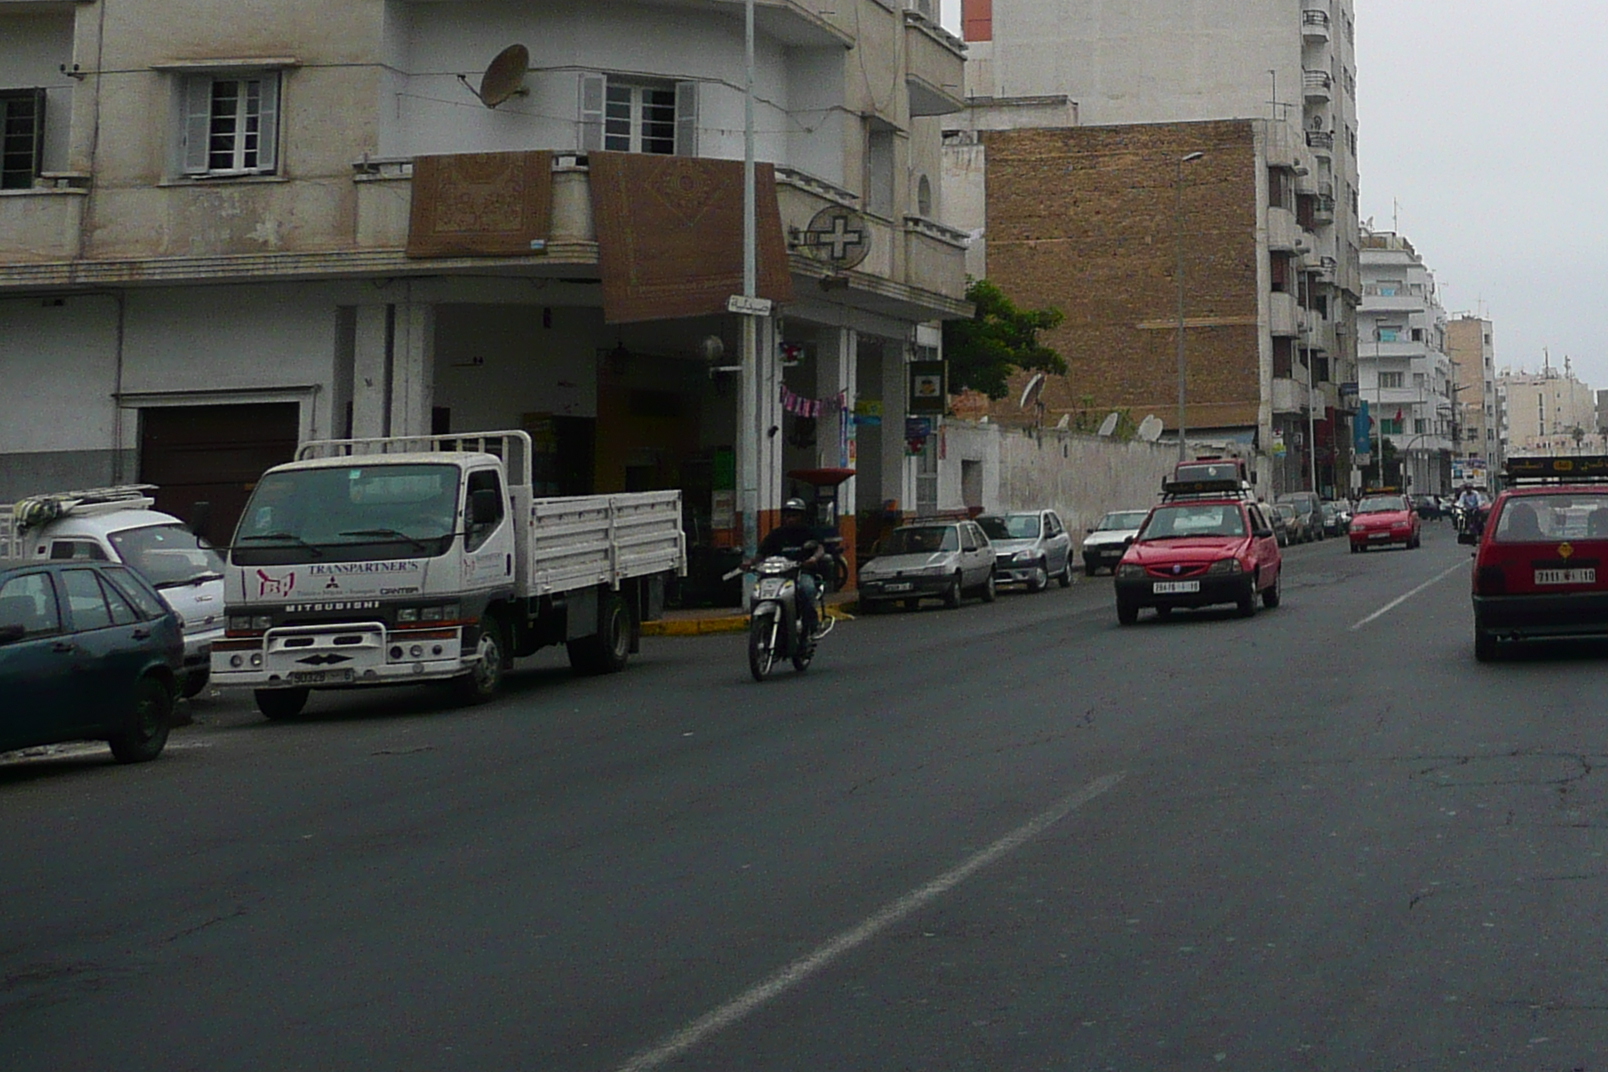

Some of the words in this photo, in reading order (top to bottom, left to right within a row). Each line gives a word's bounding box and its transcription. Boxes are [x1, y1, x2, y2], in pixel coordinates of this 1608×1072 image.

[308, 561, 419, 575] TRANSPARTNER'S
[380, 587, 419, 595] CANTER
[285, 601, 380, 612] MITSUBISHI
